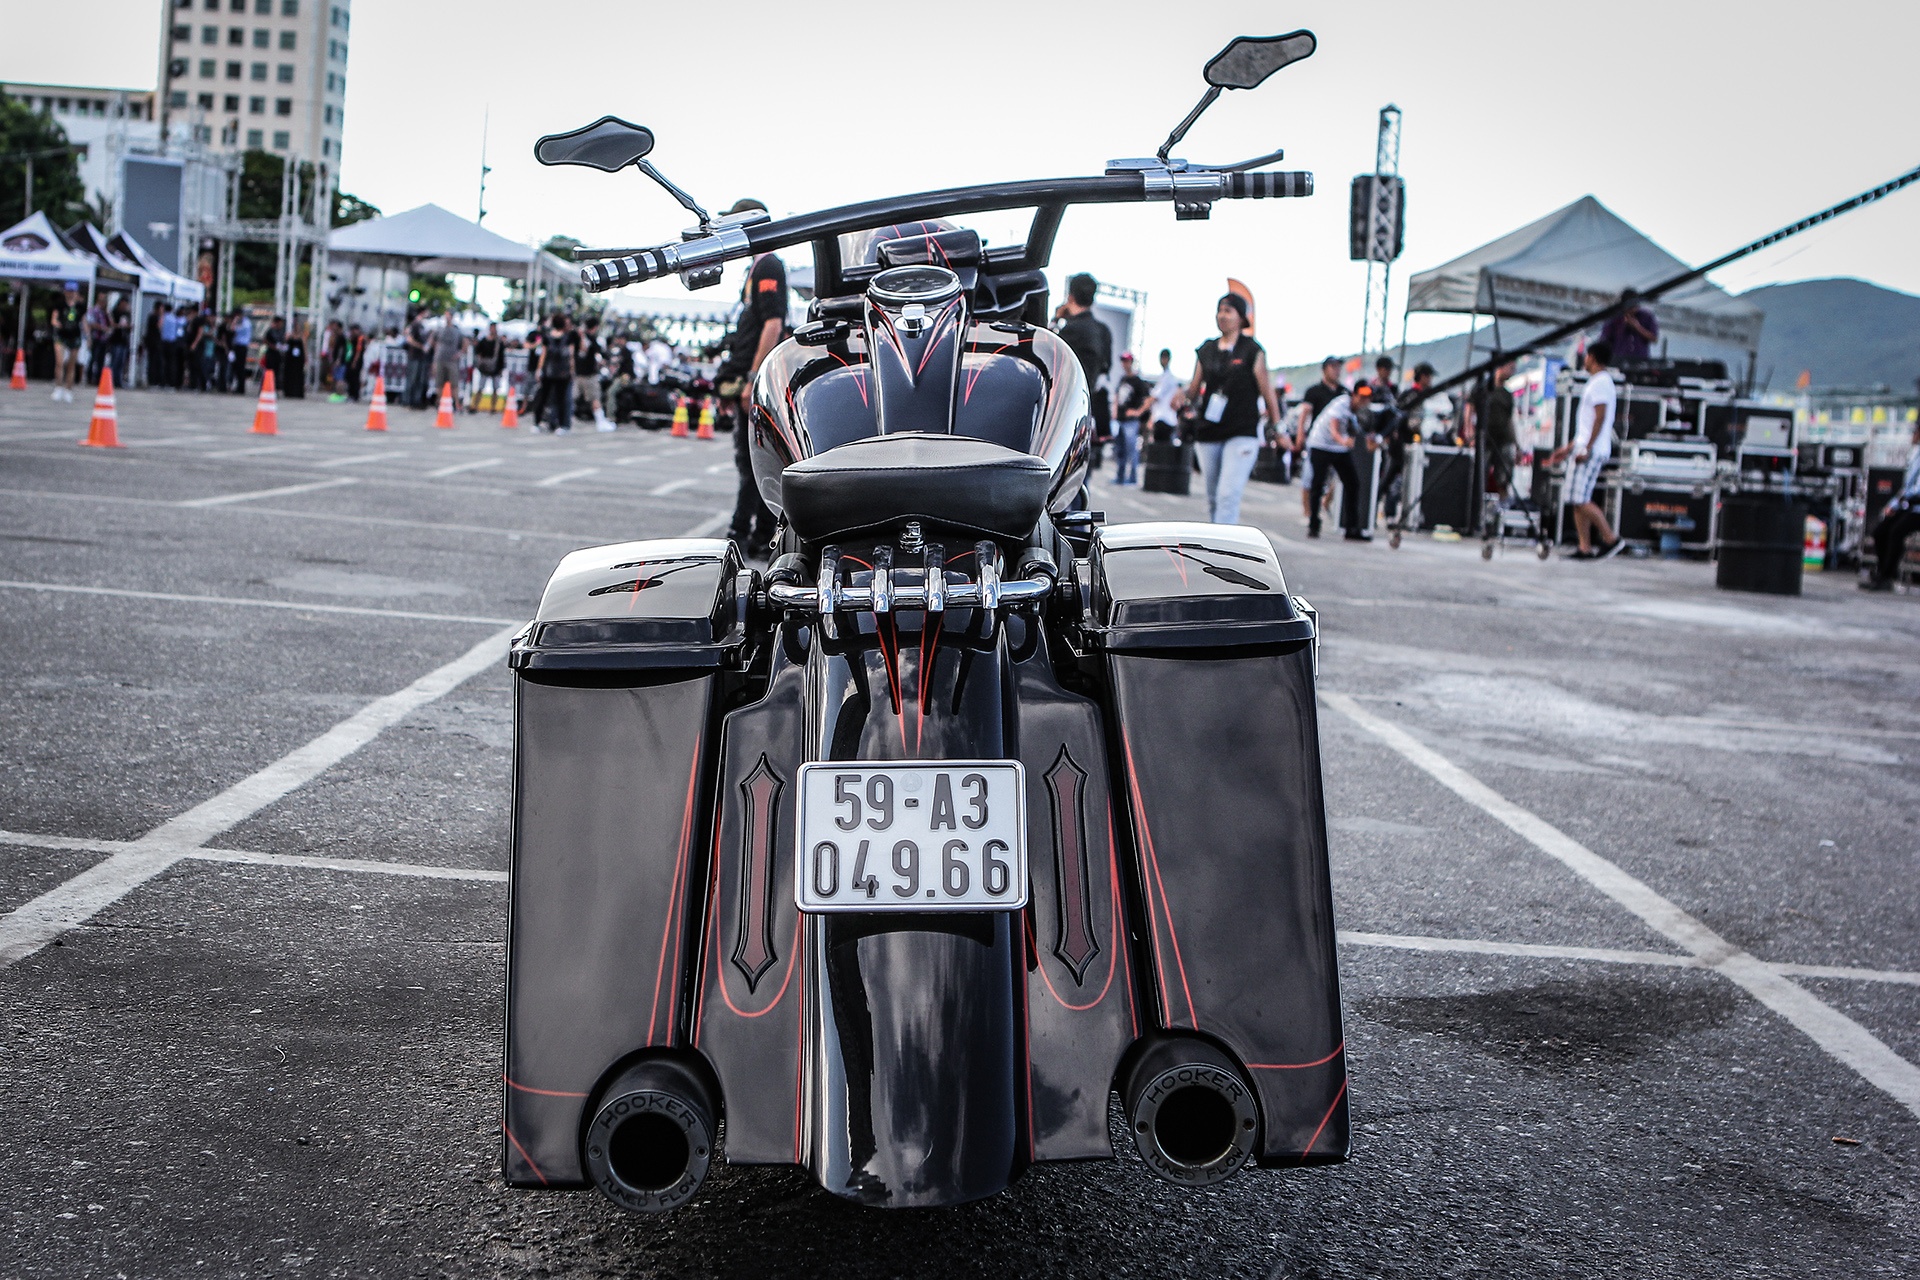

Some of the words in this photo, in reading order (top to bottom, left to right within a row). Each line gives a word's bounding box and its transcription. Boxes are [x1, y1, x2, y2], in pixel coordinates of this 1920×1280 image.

[834, 773, 989, 831] 59-A3
[811, 838, 1011, 899] 049.66
[1146, 1068, 1244, 1104] HOOKER
[600, 1094, 697, 1129] HOOKER
[1149, 1149, 1196, 1181] TUNED
[1206, 1147, 1244, 1180] FLOW
[602, 1175, 648, 1207] TUNED
[658, 1173, 697, 1206] FLOW
